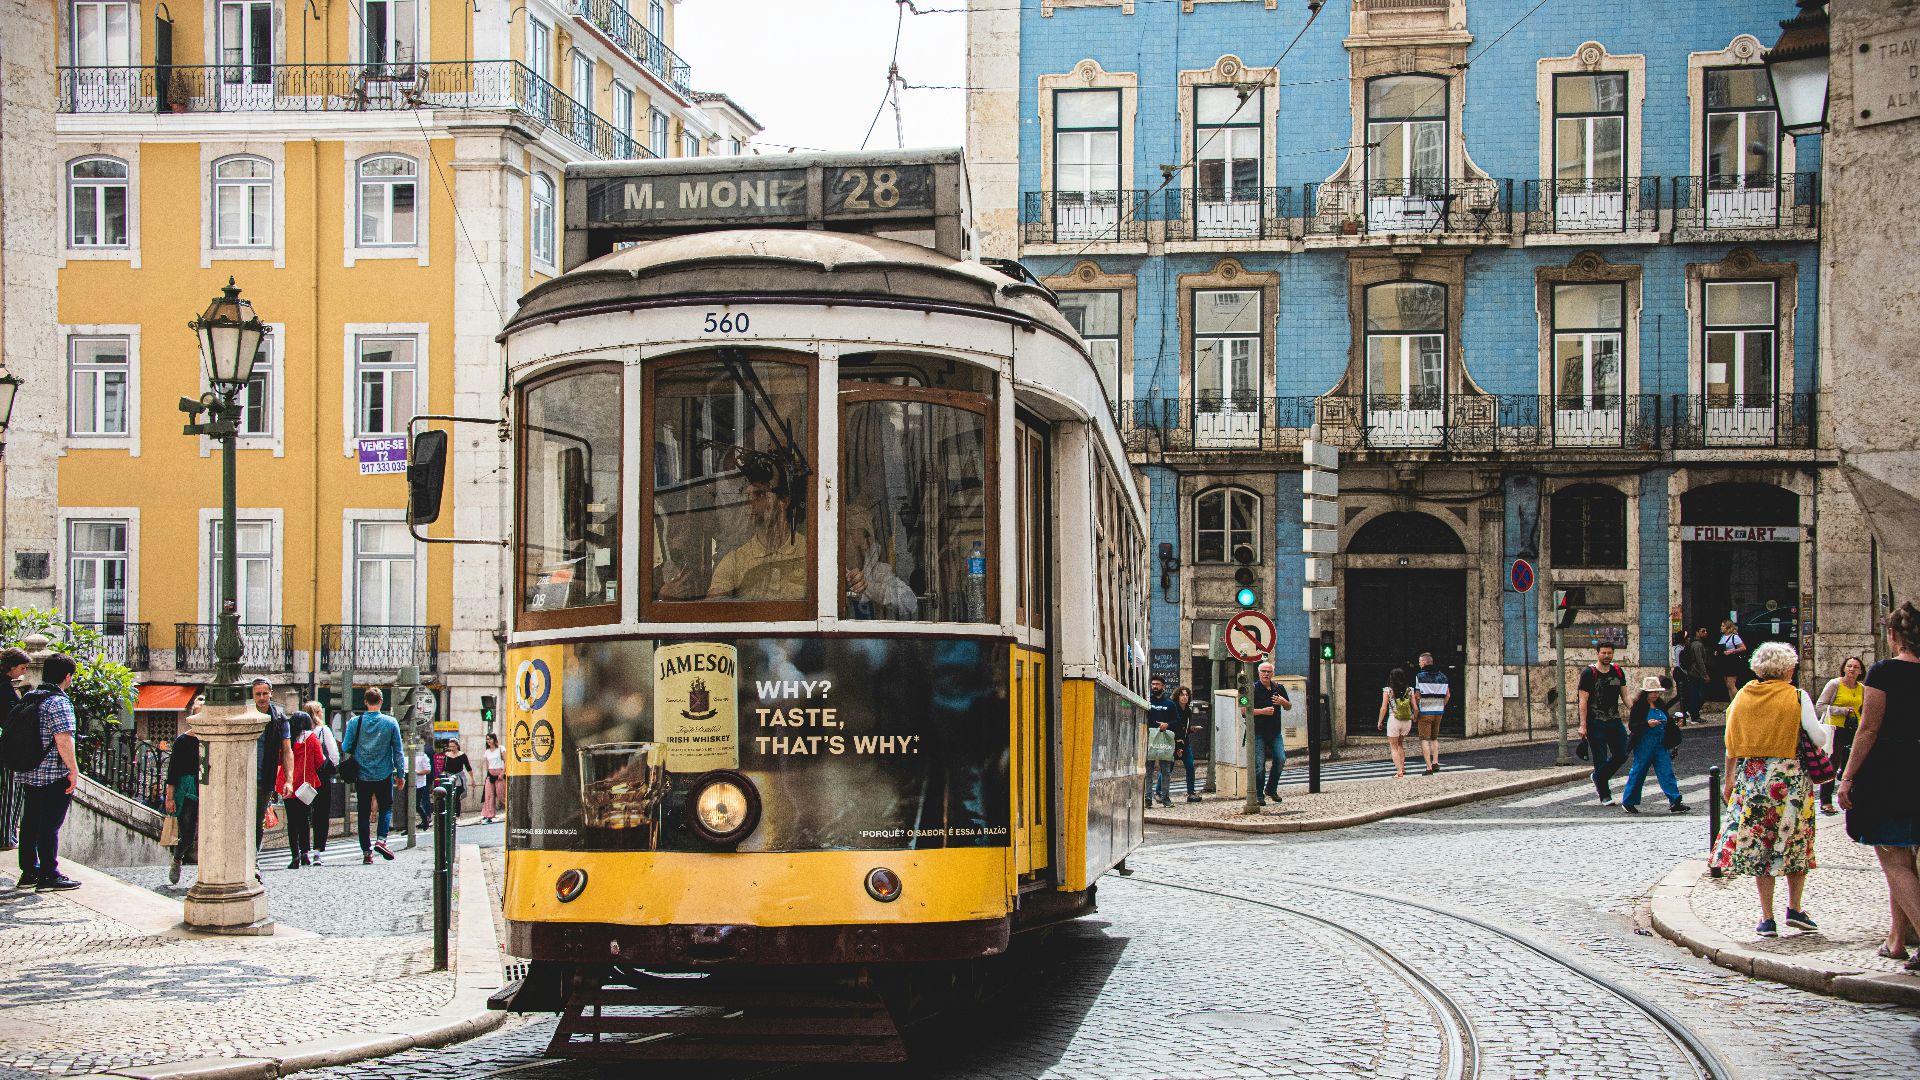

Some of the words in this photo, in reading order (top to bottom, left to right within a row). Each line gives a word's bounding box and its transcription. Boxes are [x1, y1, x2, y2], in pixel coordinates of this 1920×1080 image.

[1879, 39, 1918, 60] TRAV
[1886, 90, 1919, 109] ALM
[623, 183, 665, 210] M.
[679, 180, 806, 209] MONIZ
[842, 167, 900, 209] 28
[703, 312, 750, 333] 560
[360, 440, 405, 452] VENDE-SE
[377, 450, 389, 461] T2
[361, 463, 375, 473] 917
[376, 462, 391, 473] 333
[391, 461, 406, 471] 035
[1694, 527, 1734, 541] FOLK
[1747, 527, 1777, 541] ART
[532, 593, 547, 606] 08
[660, 653, 735, 680] JAMESON
[755, 680, 832, 699] WHY?
[755, 708, 845, 730] TASTE,
[666, 736, 690, 744] IRISH
[692, 735, 730, 743] WHISKEY
[755, 735, 845, 755] THAT'S
[948, 826, 954, 836] É
[955, 828, 975, 836] ESSA
[976, 827, 983, 835] A
[983, 826, 1007, 835] RAZÃO
